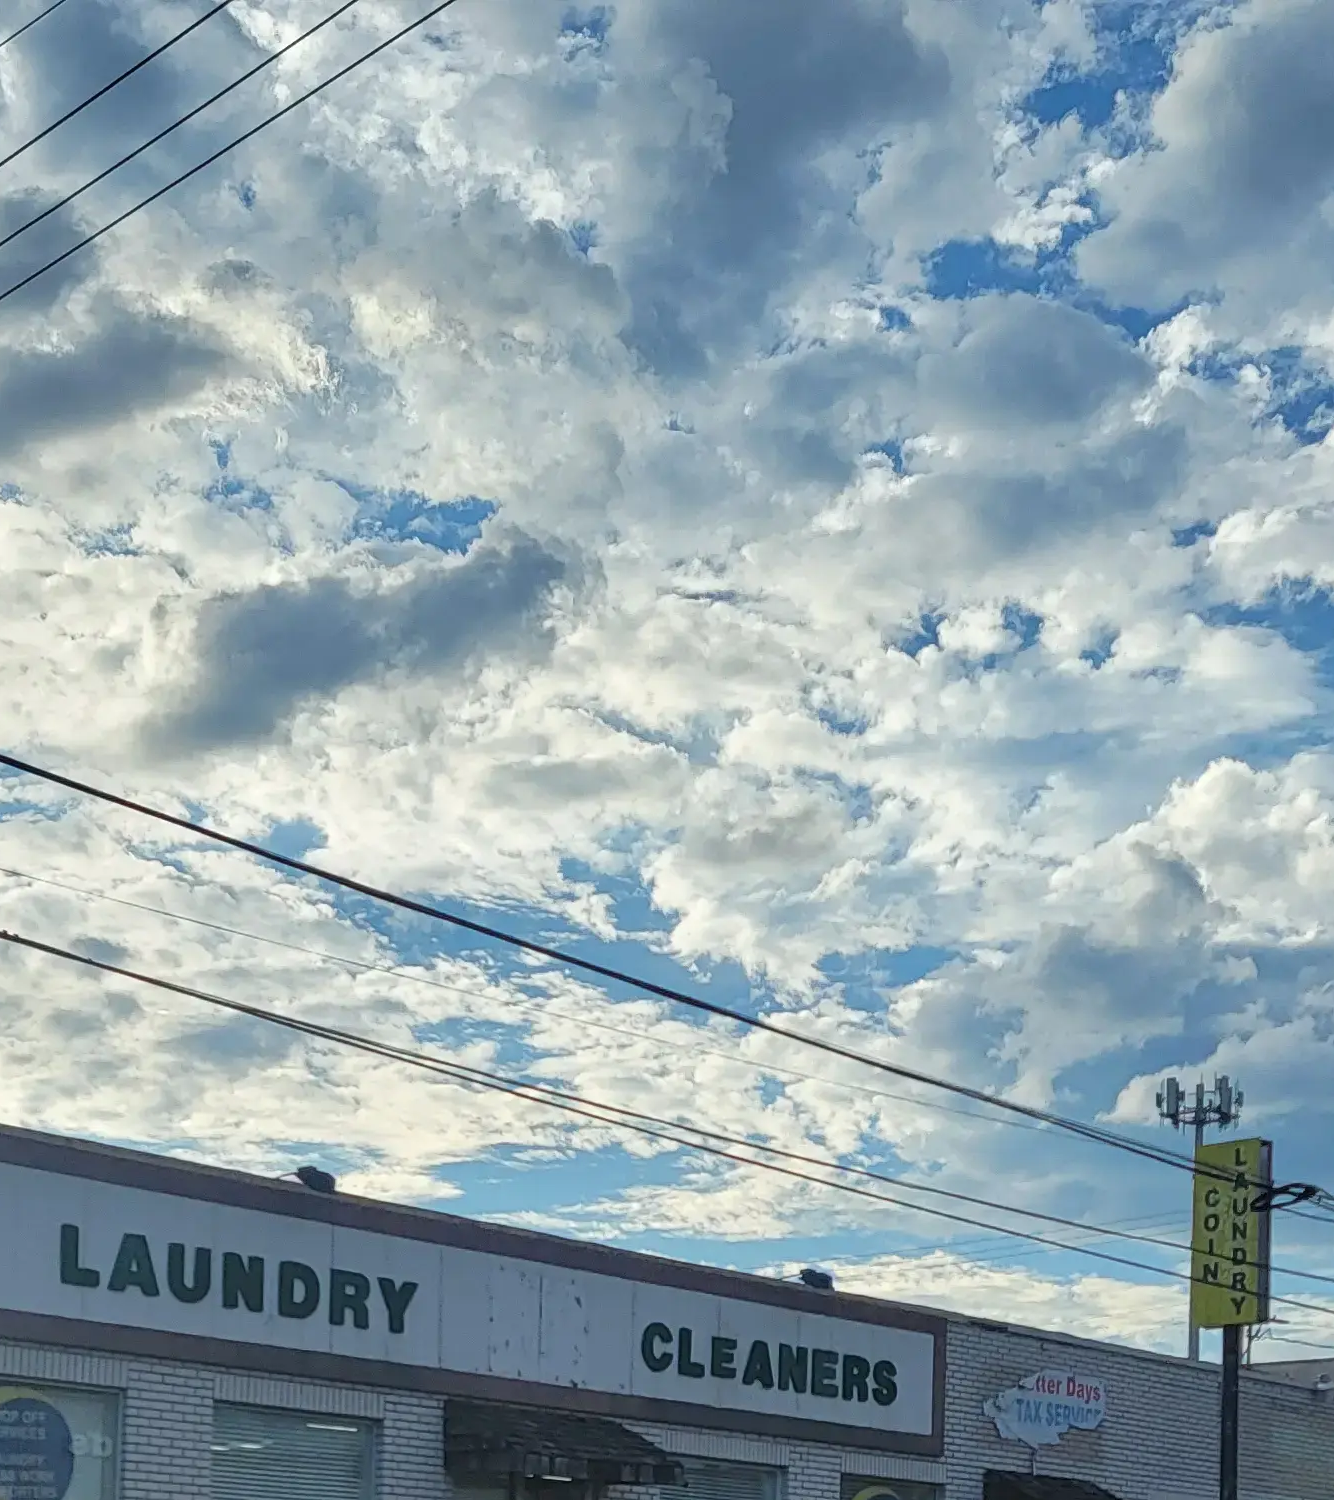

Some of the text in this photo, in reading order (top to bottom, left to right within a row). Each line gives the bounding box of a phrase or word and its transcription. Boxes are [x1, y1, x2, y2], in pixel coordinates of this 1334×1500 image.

[1203, 1186, 1221, 1285] COIN
[1231, 1147, 1249, 1316] LAUNDRY
[60, 1223, 419, 1335] LAUNDRY
[641, 1321, 899, 1407] CLEANERS
[1029, 1375, 1102, 1405] tter Days
[1016, 1398, 1043, 1424] TAX
